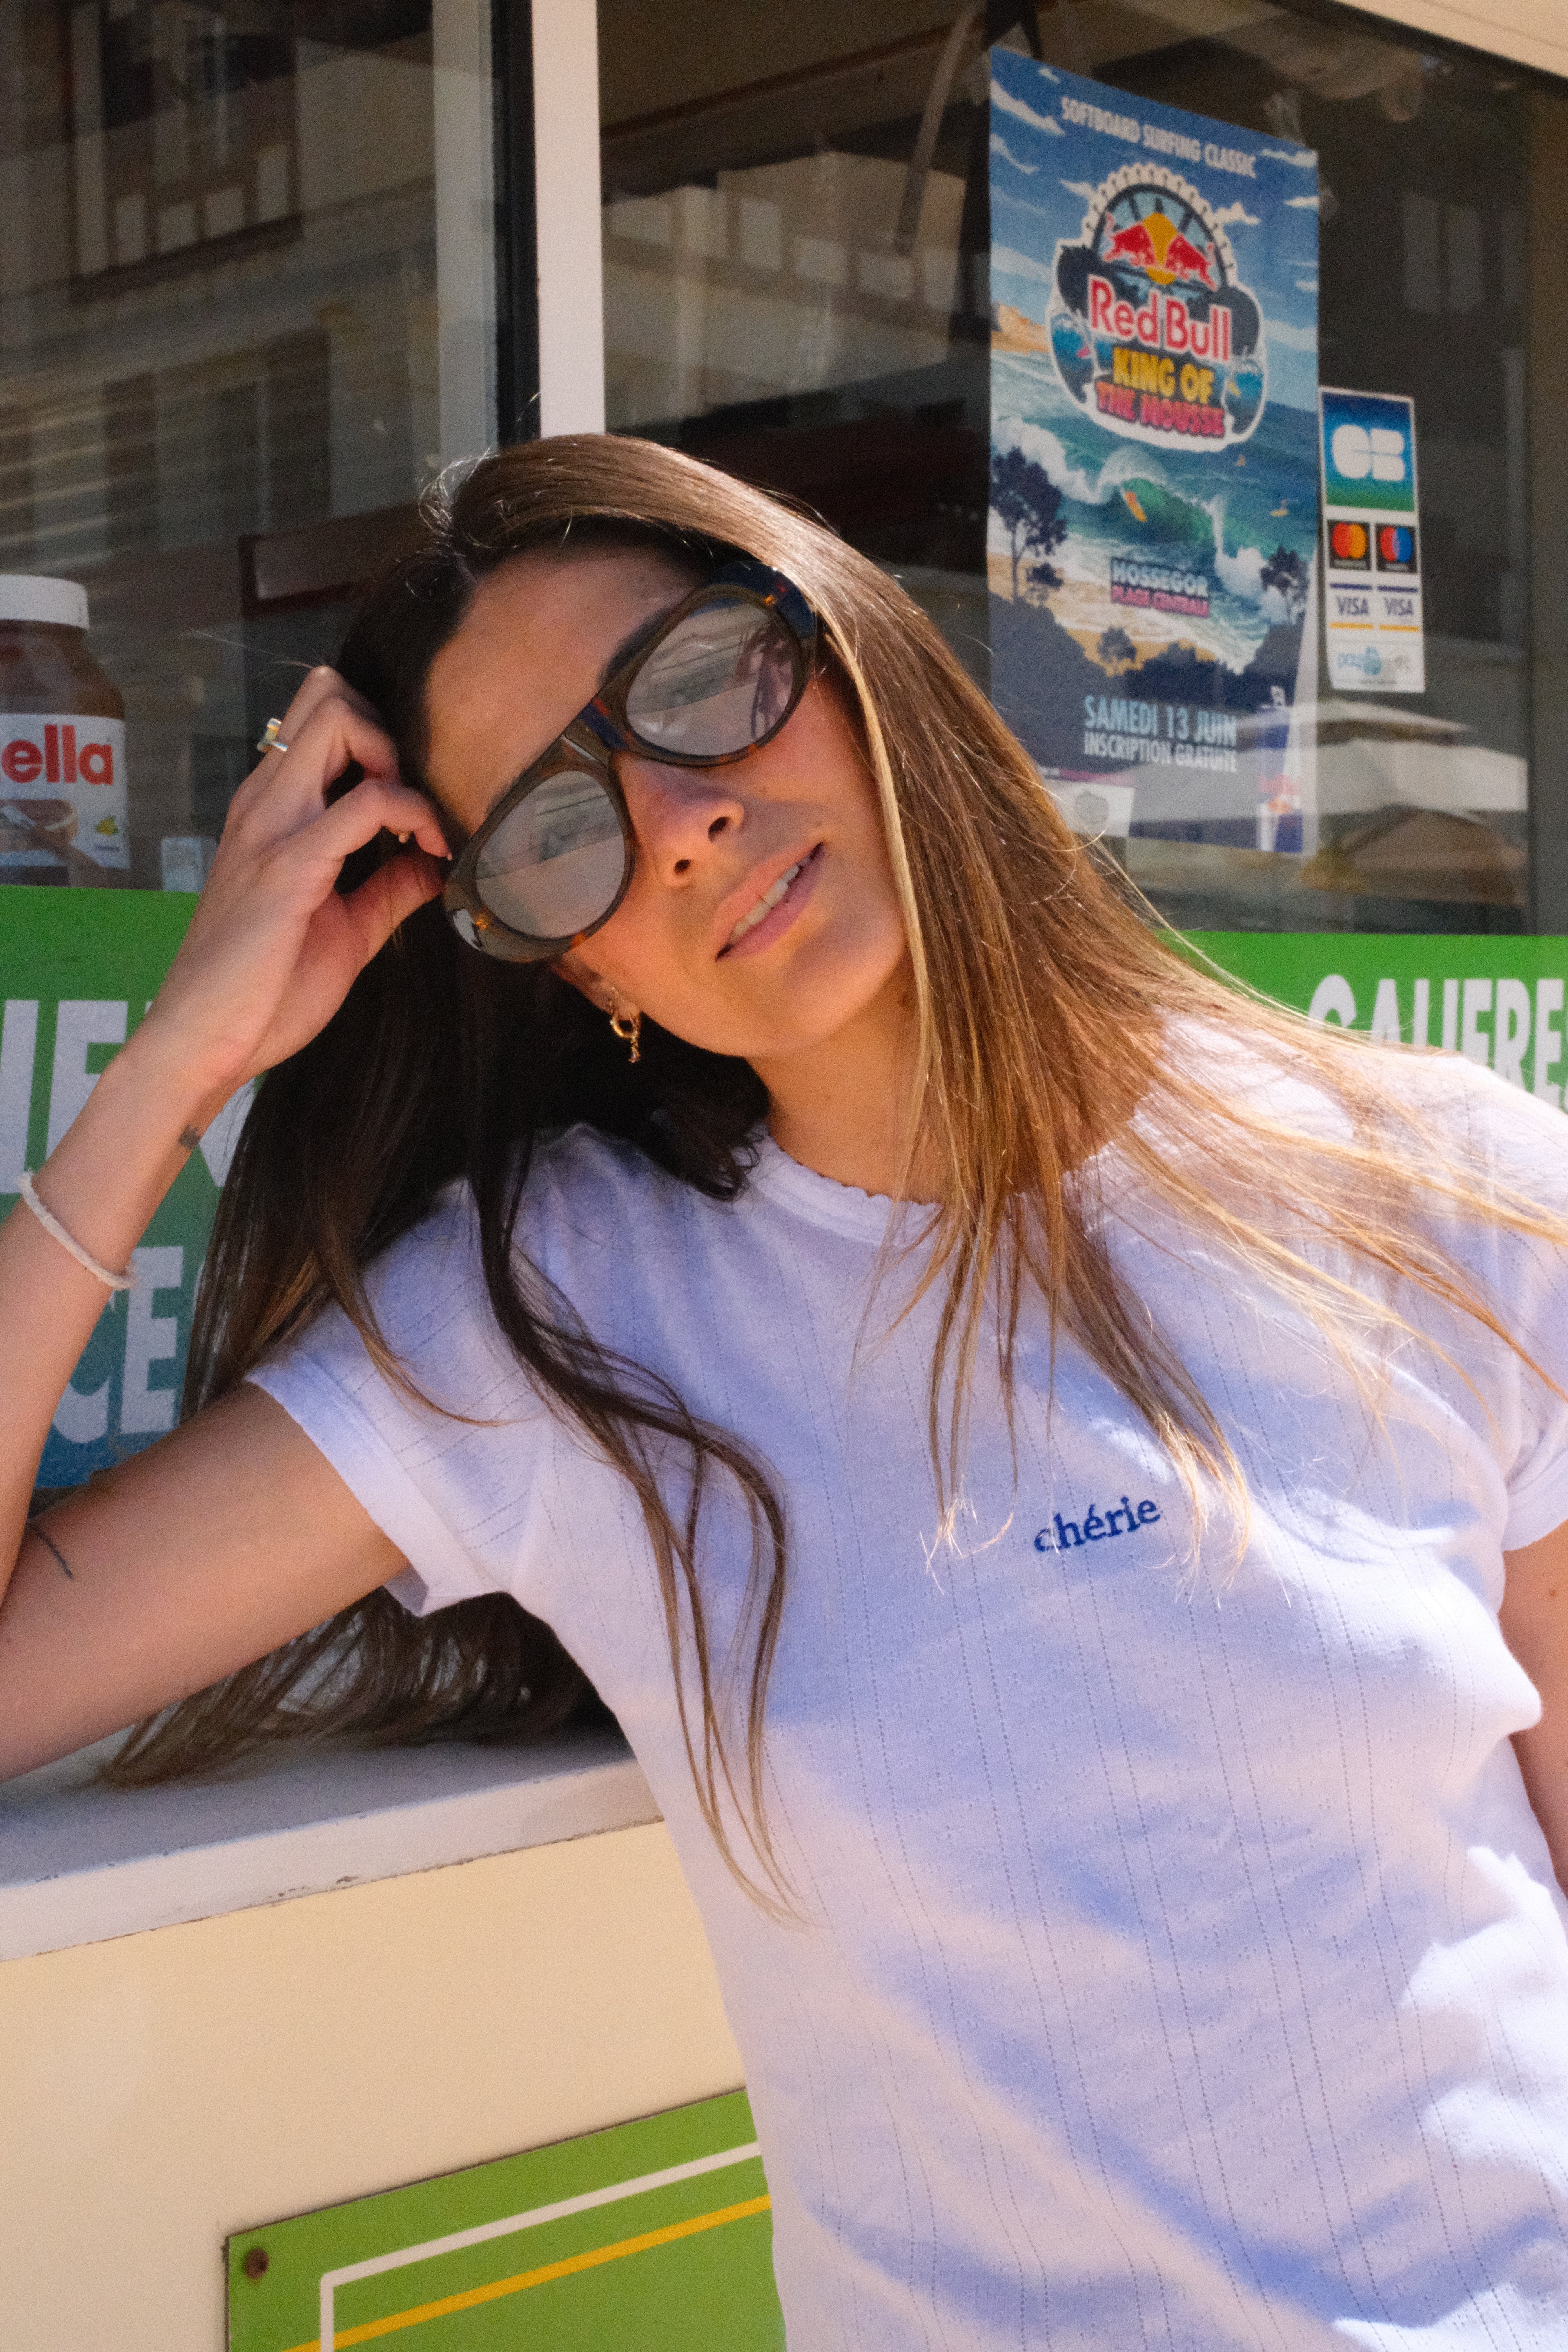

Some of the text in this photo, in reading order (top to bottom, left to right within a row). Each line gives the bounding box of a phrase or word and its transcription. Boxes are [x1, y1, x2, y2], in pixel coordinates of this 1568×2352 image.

[1062, 96, 1256, 178] SOFTBOARD SURFING CLASSIC
[1089, 277, 1230, 363] Red Bull
[1113, 347, 1215, 404] KING OF
[1096, 381, 1225, 437] THE MOUSSE
[1112, 561, 1209, 597] HOSSEGOR
[1336, 596, 1414, 617] VISA VISA
[1084, 695, 1237, 746] SAMEDI 13 JUIN
[1, 724, 114, 786] ella
[1084, 731, 1237, 773] INSCRIPTION GRATUITE
[1308, 974, 1568, 1116] AUFRE
[1034, 1496, 1161, 1552] chérie
